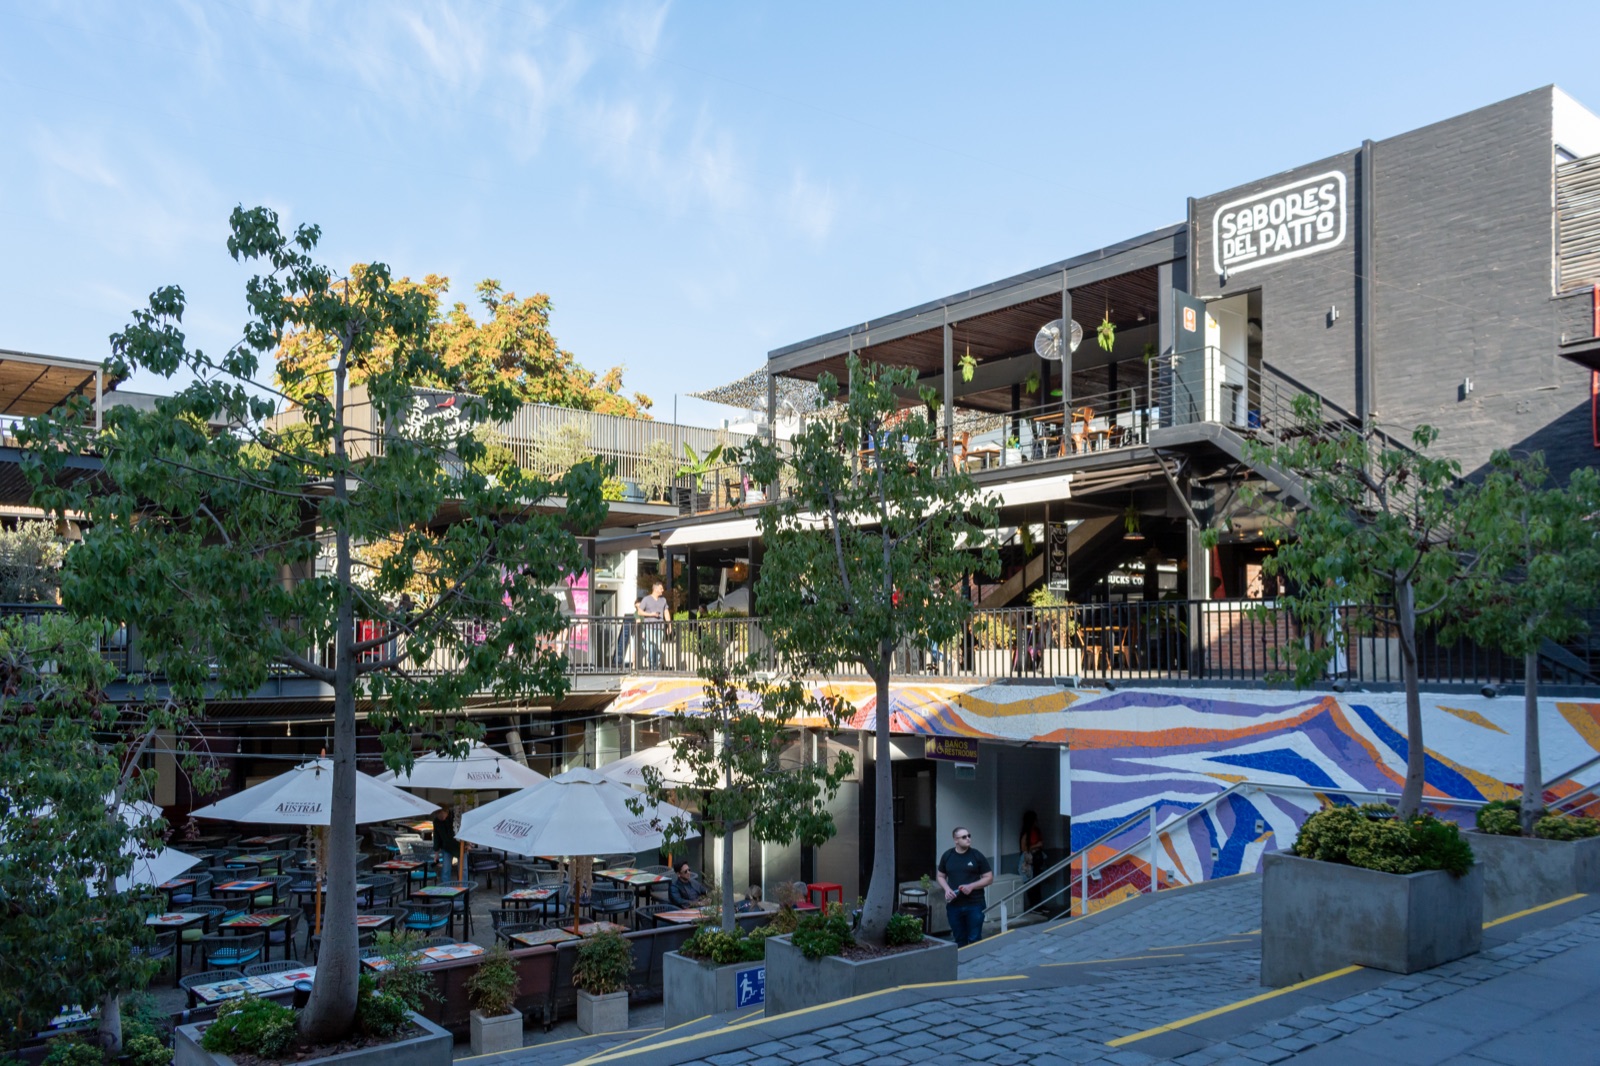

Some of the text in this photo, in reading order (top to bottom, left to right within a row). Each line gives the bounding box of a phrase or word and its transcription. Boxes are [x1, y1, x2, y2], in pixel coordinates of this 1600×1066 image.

[1221, 183, 1337, 239] SABORES
[1223, 211, 1334, 263] DEL PATIO
[1133, 577, 1145, 585] CO
[944, 739, 969, 749] BAÑOS
[944, 748, 978, 758] RESTROOMS
[467, 772, 503, 781] AUSTRAL
[275, 802, 323, 813] AUSTRAL
[493, 819, 534, 837] AUSTRAL
[627, 823, 664, 836] AUSTR
